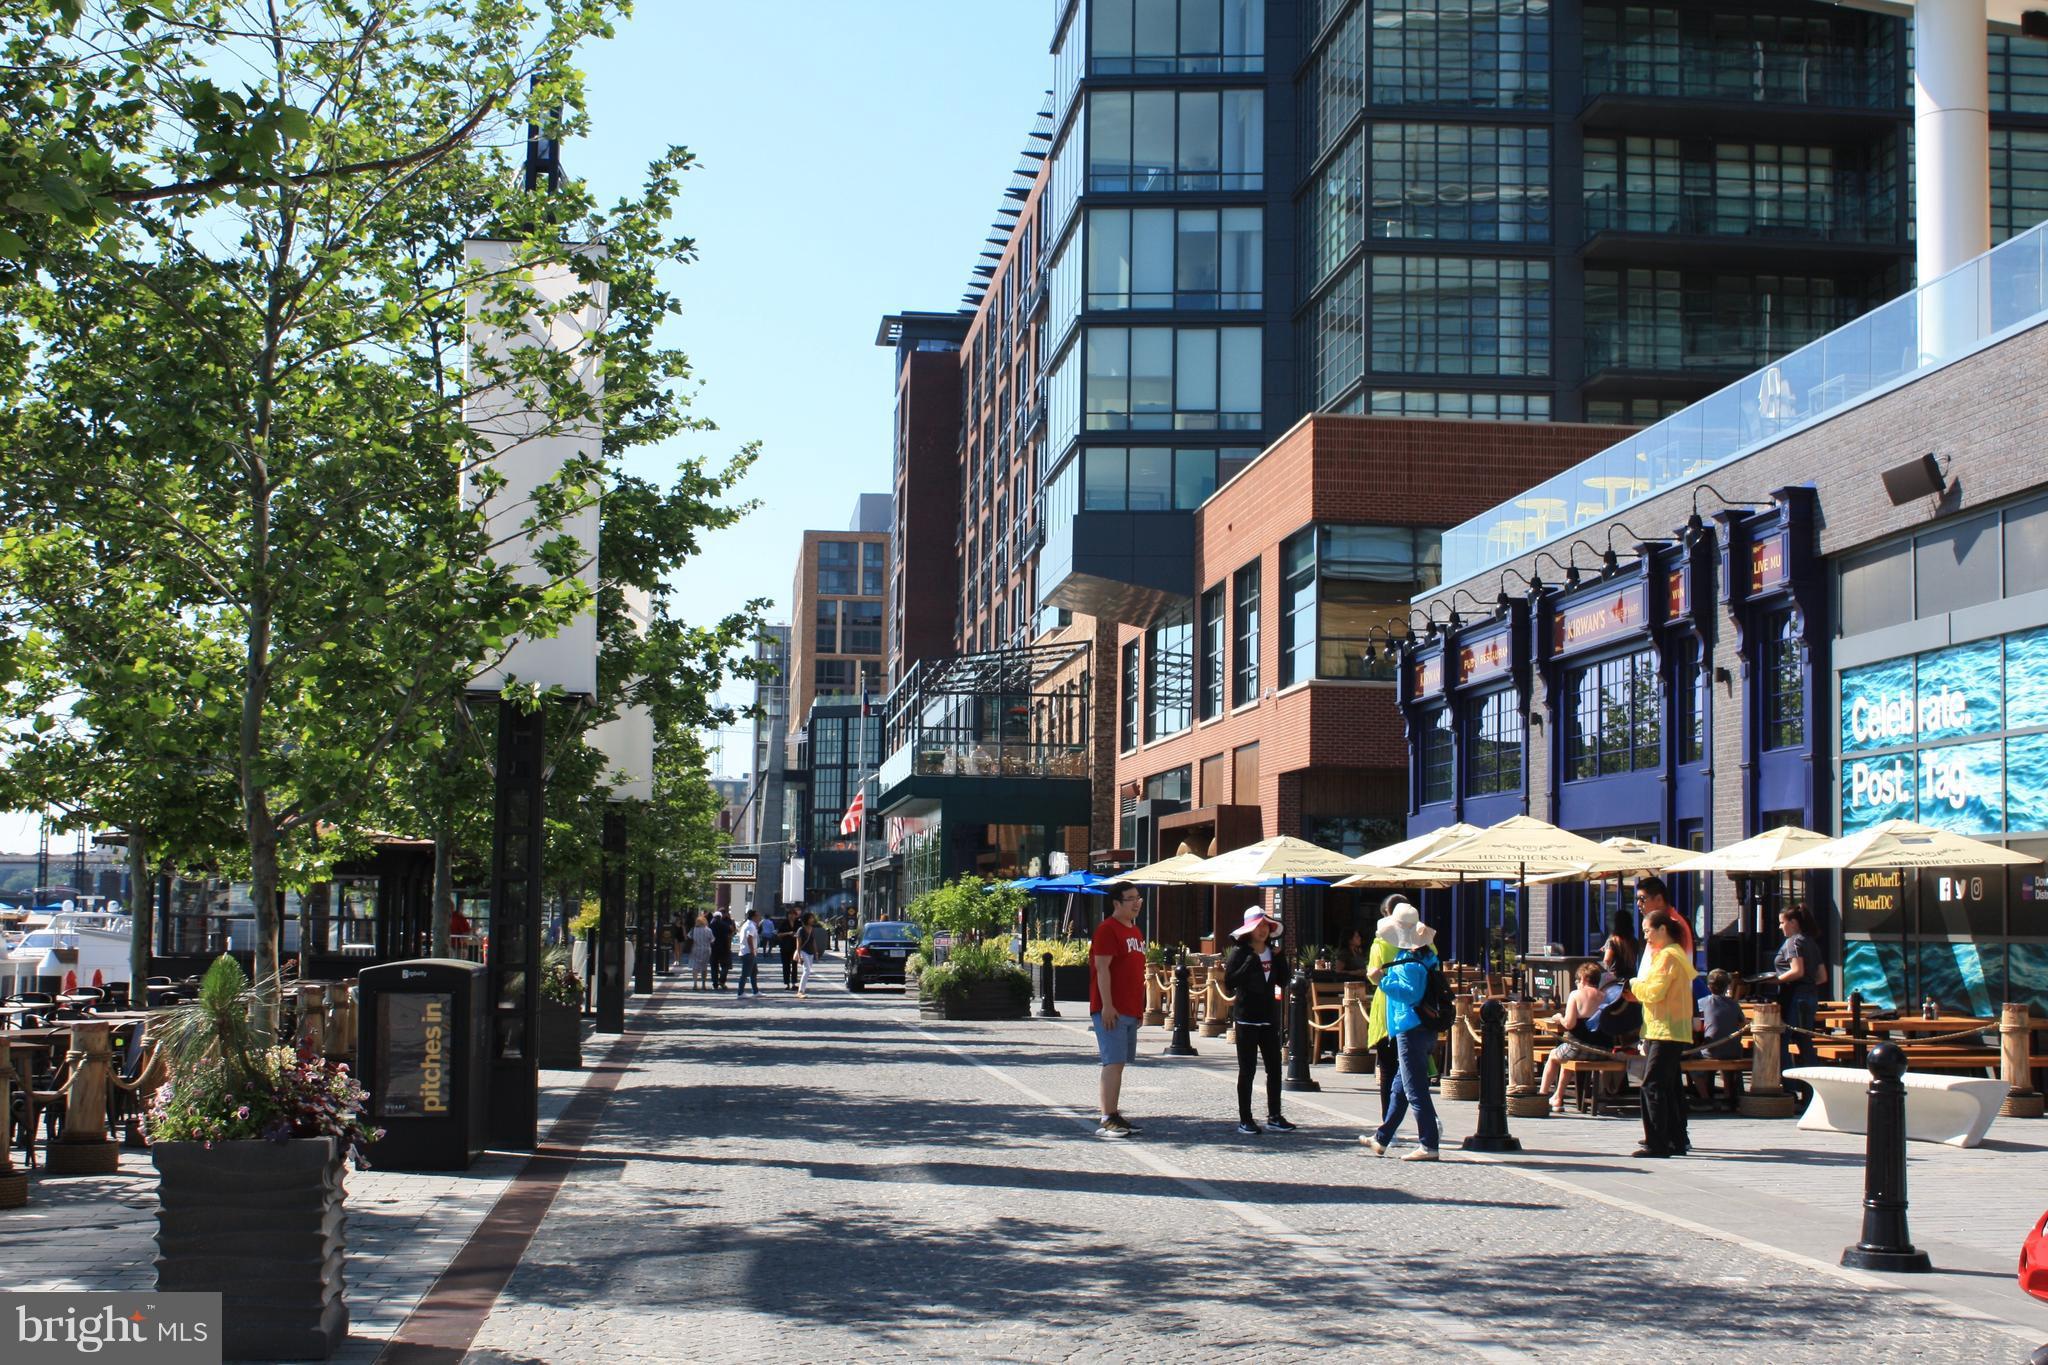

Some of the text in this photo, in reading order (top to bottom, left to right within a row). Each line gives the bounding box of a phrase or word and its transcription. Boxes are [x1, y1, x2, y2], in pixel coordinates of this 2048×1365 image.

[1753, 559, 1769, 575] LIVE
[1567, 609, 1606, 640] KIRWAN'S
[1852, 684, 1972, 742] Celebrate.
[1852, 759, 1910, 808] Post.
[1477, 854, 1559, 862] HENDRICK'S
[1853, 895, 1893, 910] #WharfDC
[419, 1002, 448, 1112] pitches in
